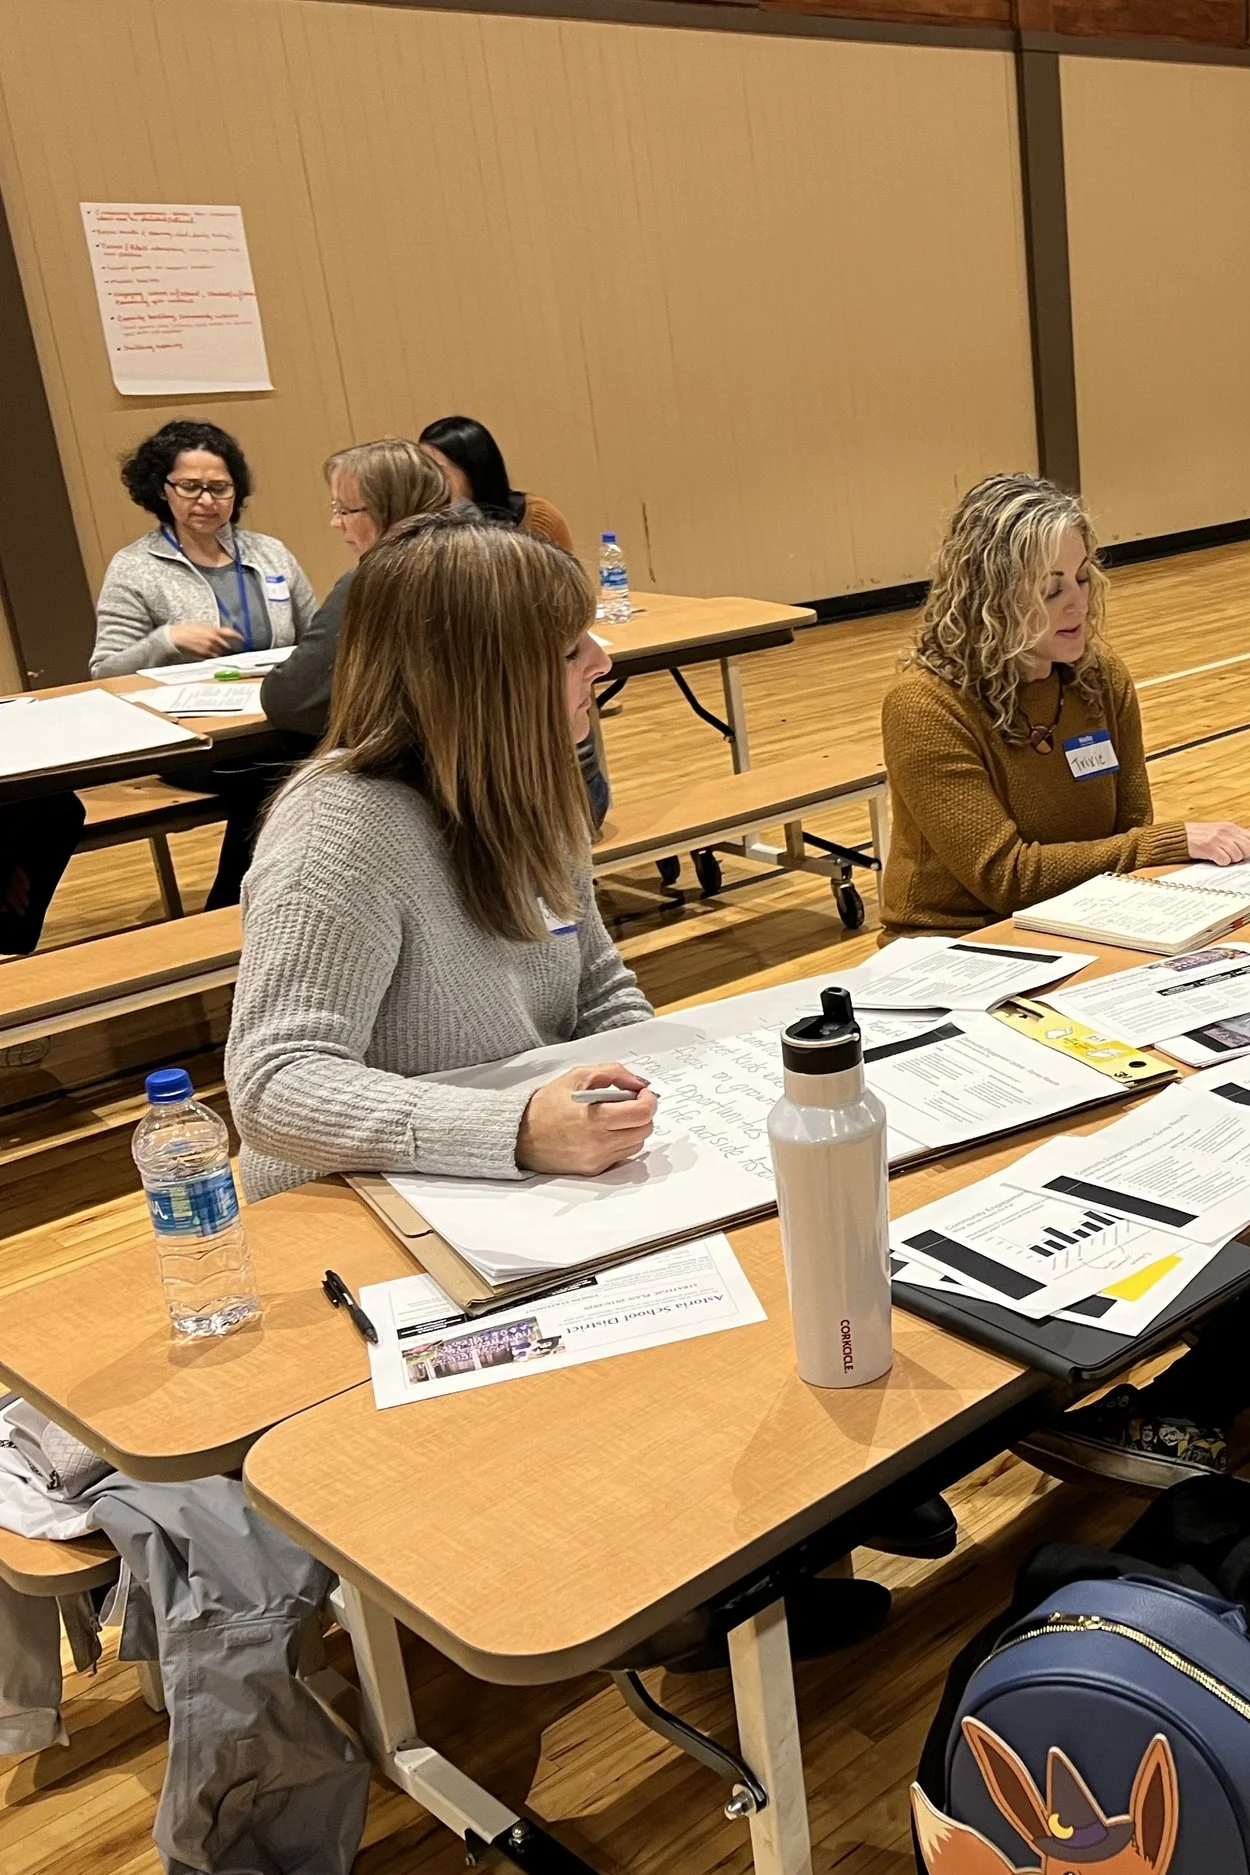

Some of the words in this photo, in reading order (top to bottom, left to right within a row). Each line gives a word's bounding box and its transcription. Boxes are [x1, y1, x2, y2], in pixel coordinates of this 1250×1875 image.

[944, 1211, 986, 1231] Community
[675, 1293, 724, 1310] Astoria
[625, 1305, 672, 1323] School
[565, 1317, 620, 1335] District
